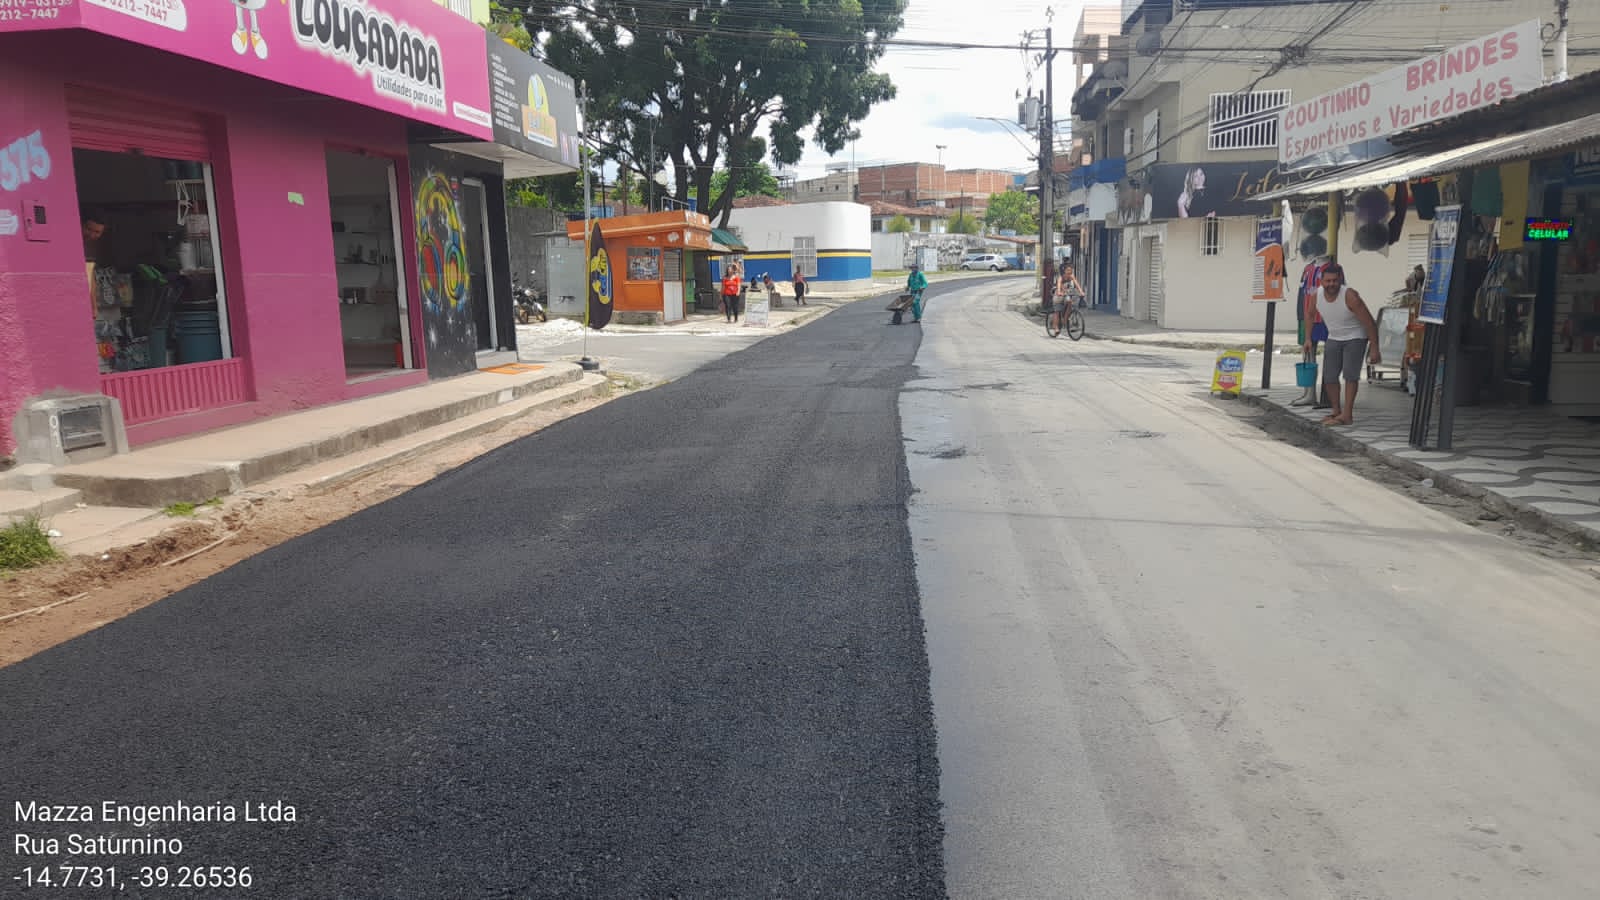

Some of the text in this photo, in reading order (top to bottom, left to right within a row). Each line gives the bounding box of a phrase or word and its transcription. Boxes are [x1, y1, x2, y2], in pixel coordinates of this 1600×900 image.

[377, 74, 411, 98] Utilidades
[413, 90, 427, 103] para
[1284, 31, 1519, 131] COUTINHO BRINDES
[1285, 76, 1513, 159] Esportivos e Variedades
[1528, 229, 1568, 238] CELULAR
